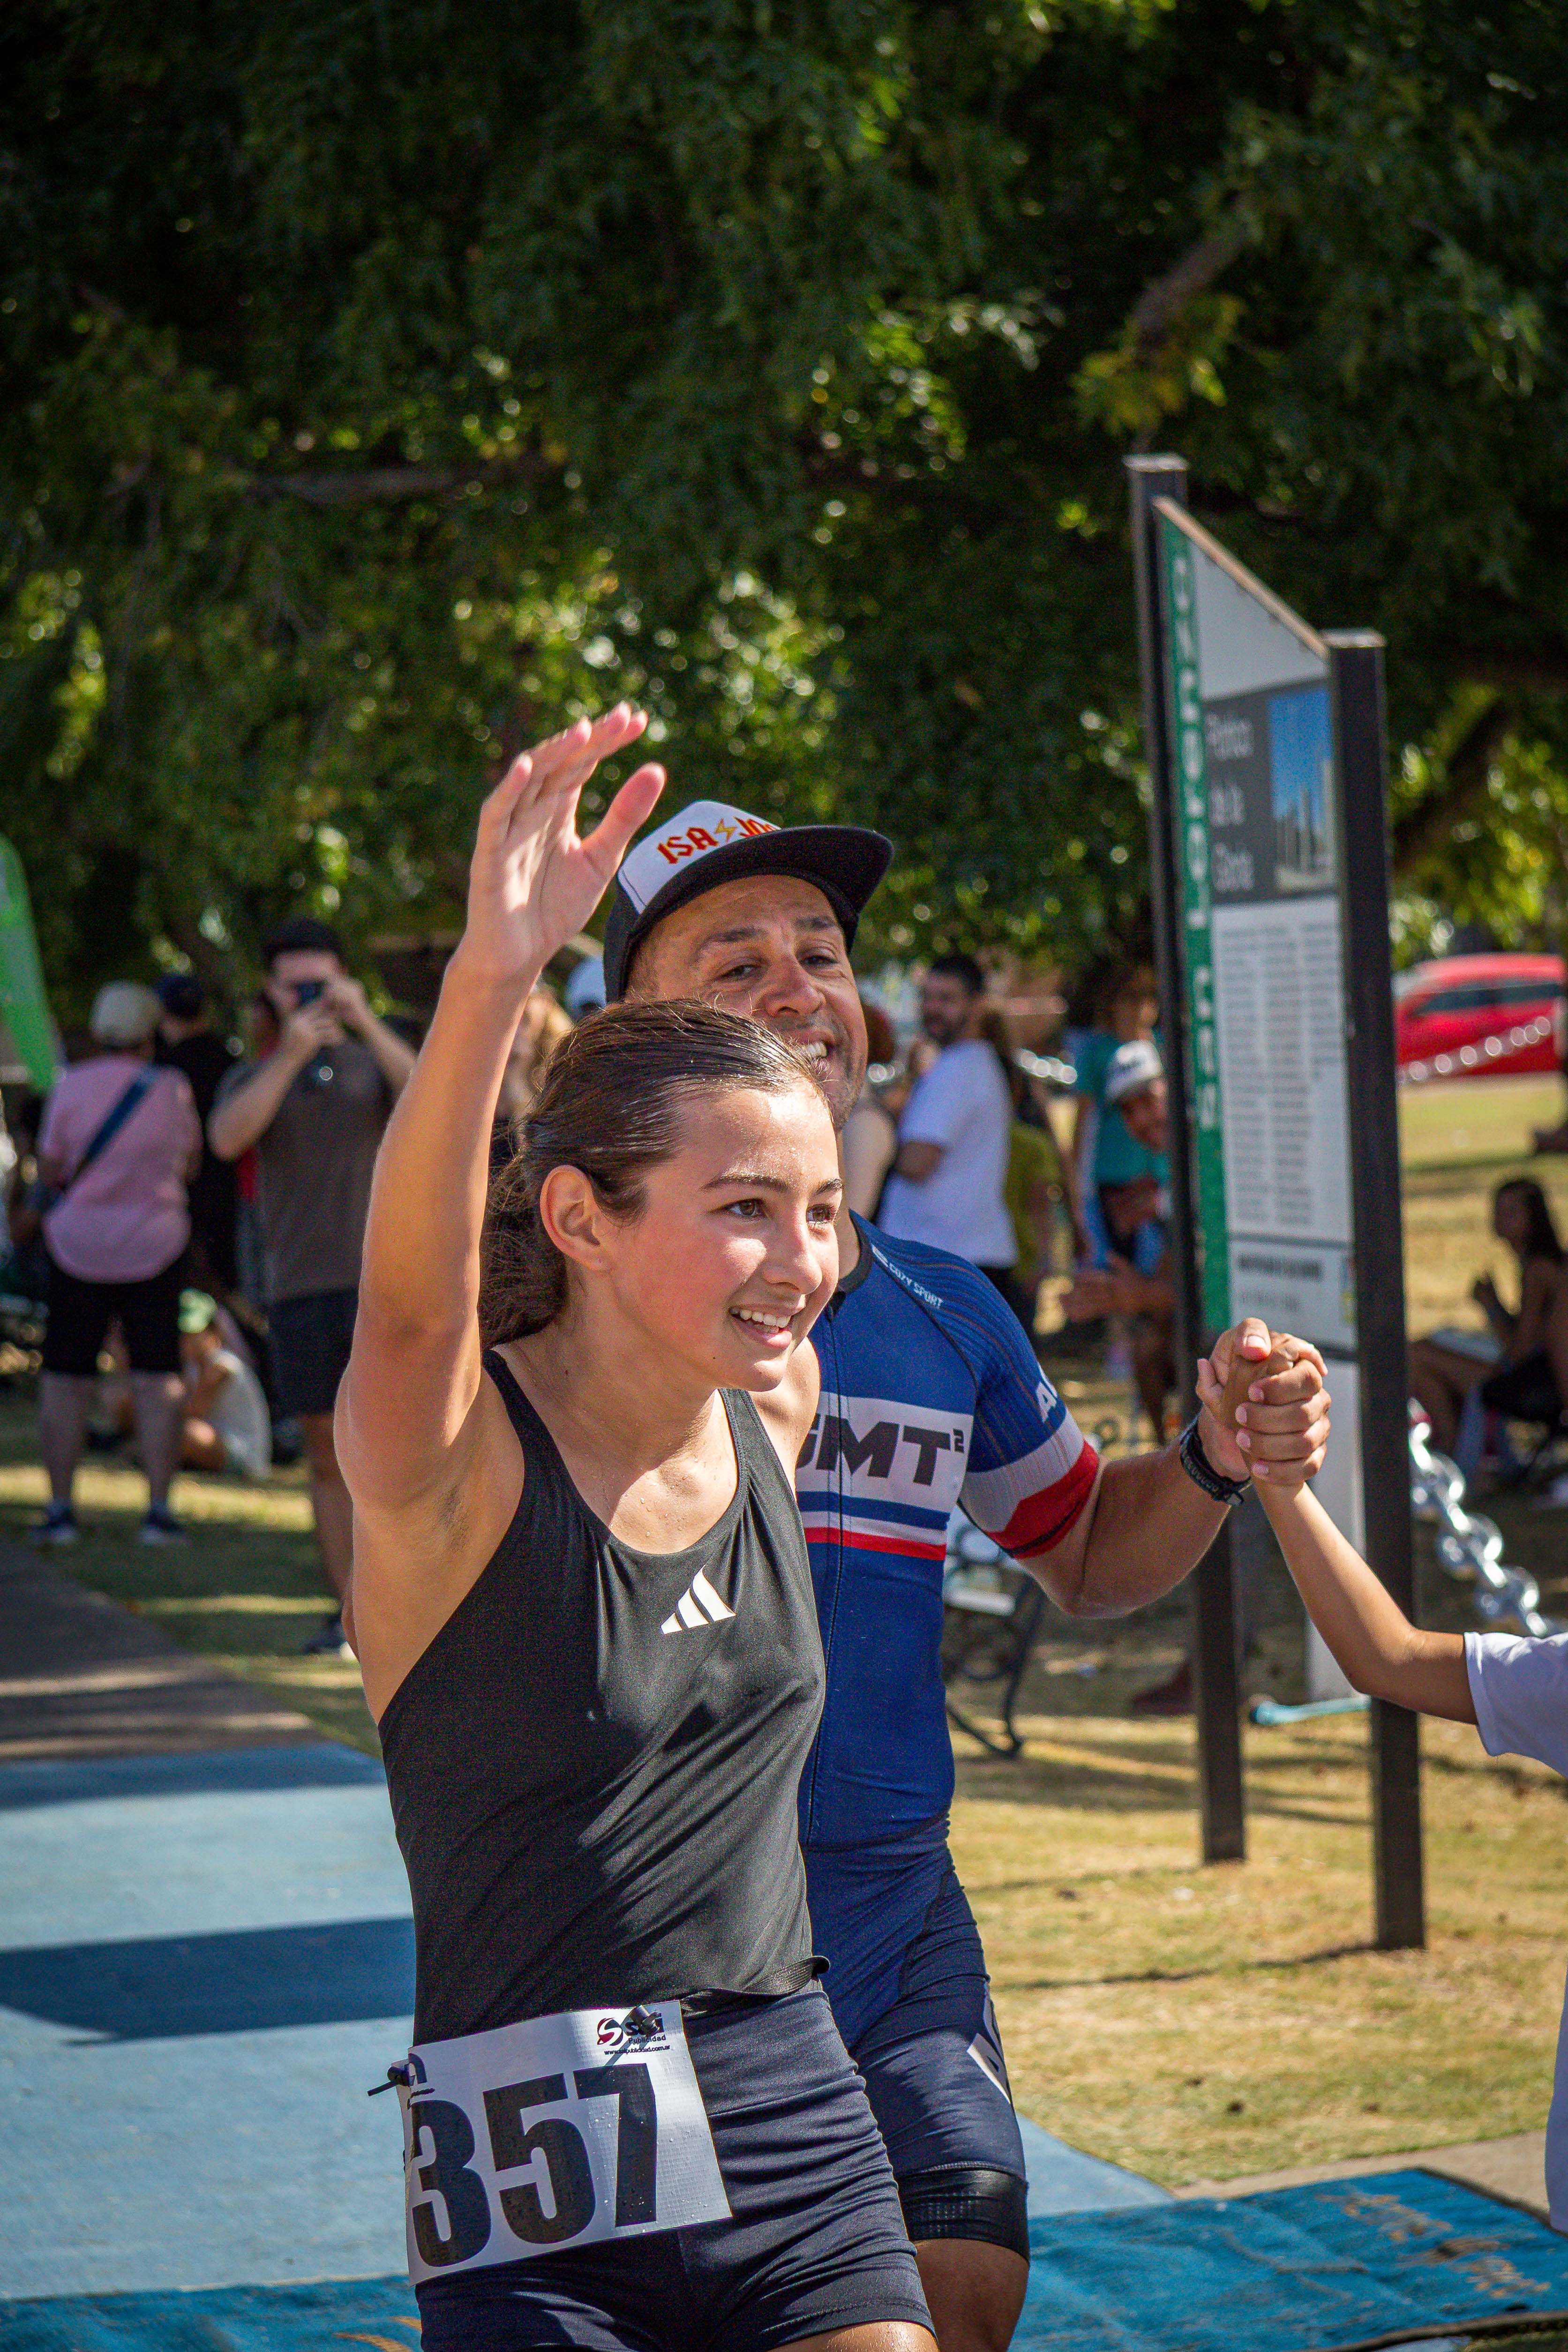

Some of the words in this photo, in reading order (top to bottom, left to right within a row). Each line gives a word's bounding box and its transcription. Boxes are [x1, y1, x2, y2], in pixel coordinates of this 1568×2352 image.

[657, 827, 719, 864] ISA
[628, 2035, 666, 2044] Publicidad
[412, 2063, 657, 2267] 357
